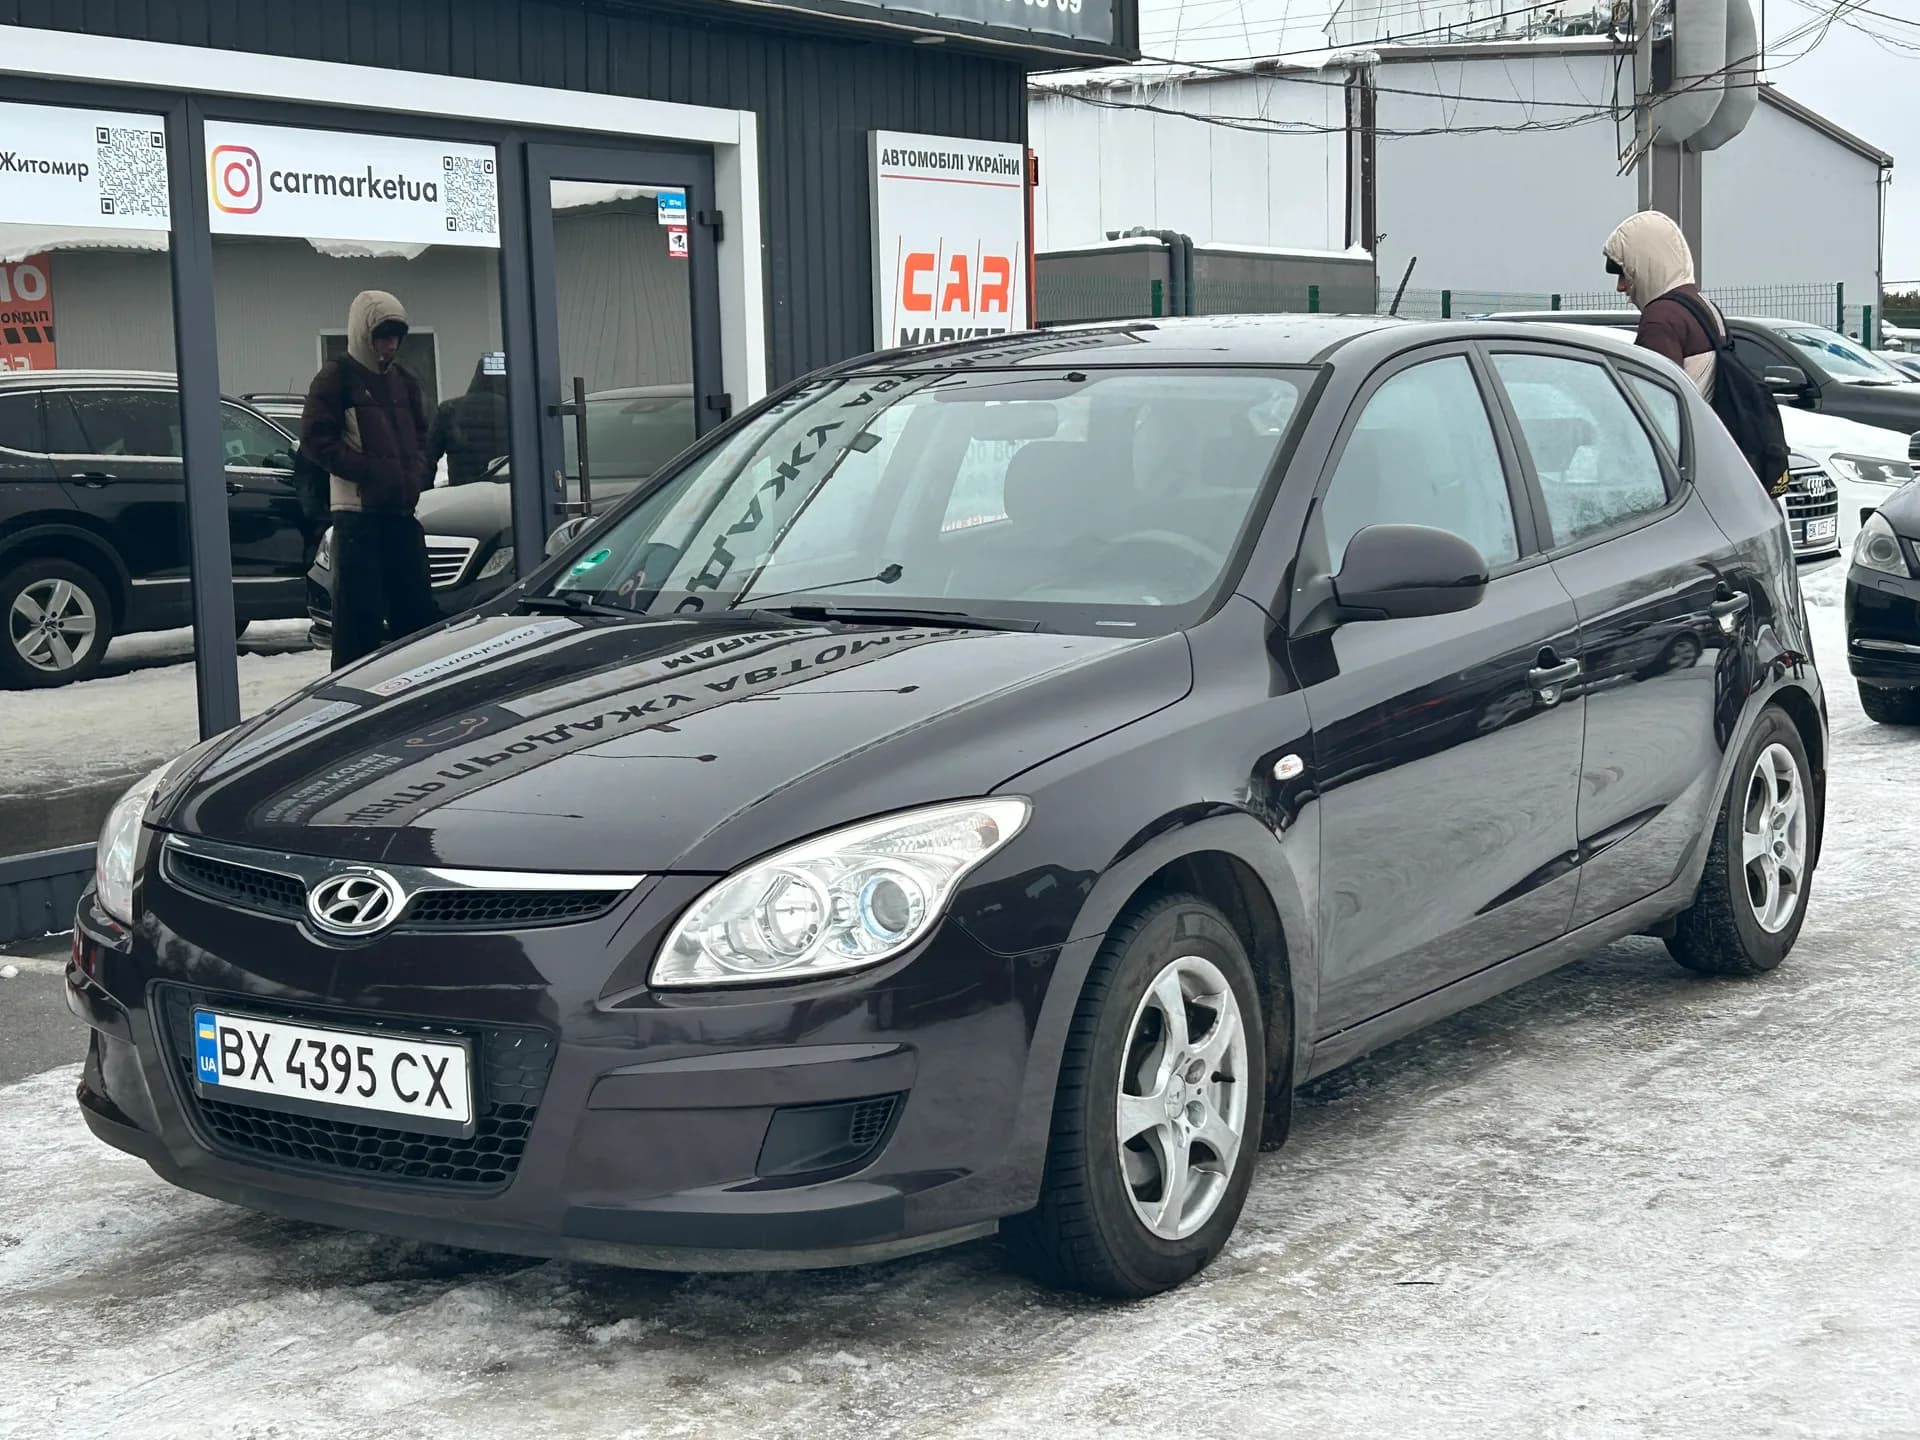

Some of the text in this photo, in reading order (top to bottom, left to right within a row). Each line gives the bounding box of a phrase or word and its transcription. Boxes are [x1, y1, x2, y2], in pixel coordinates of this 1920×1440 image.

[0, 151, 89, 183] Житомир
[882, 148, 1020, 176] АВТОМОБІЛІ УКРАЇНИ
[270, 165, 438, 203] carmarketua
[902, 252, 1010, 313] CAR
[201, 1057, 217, 1074] UA
[219, 1027, 452, 1110] BX 4395 CX
